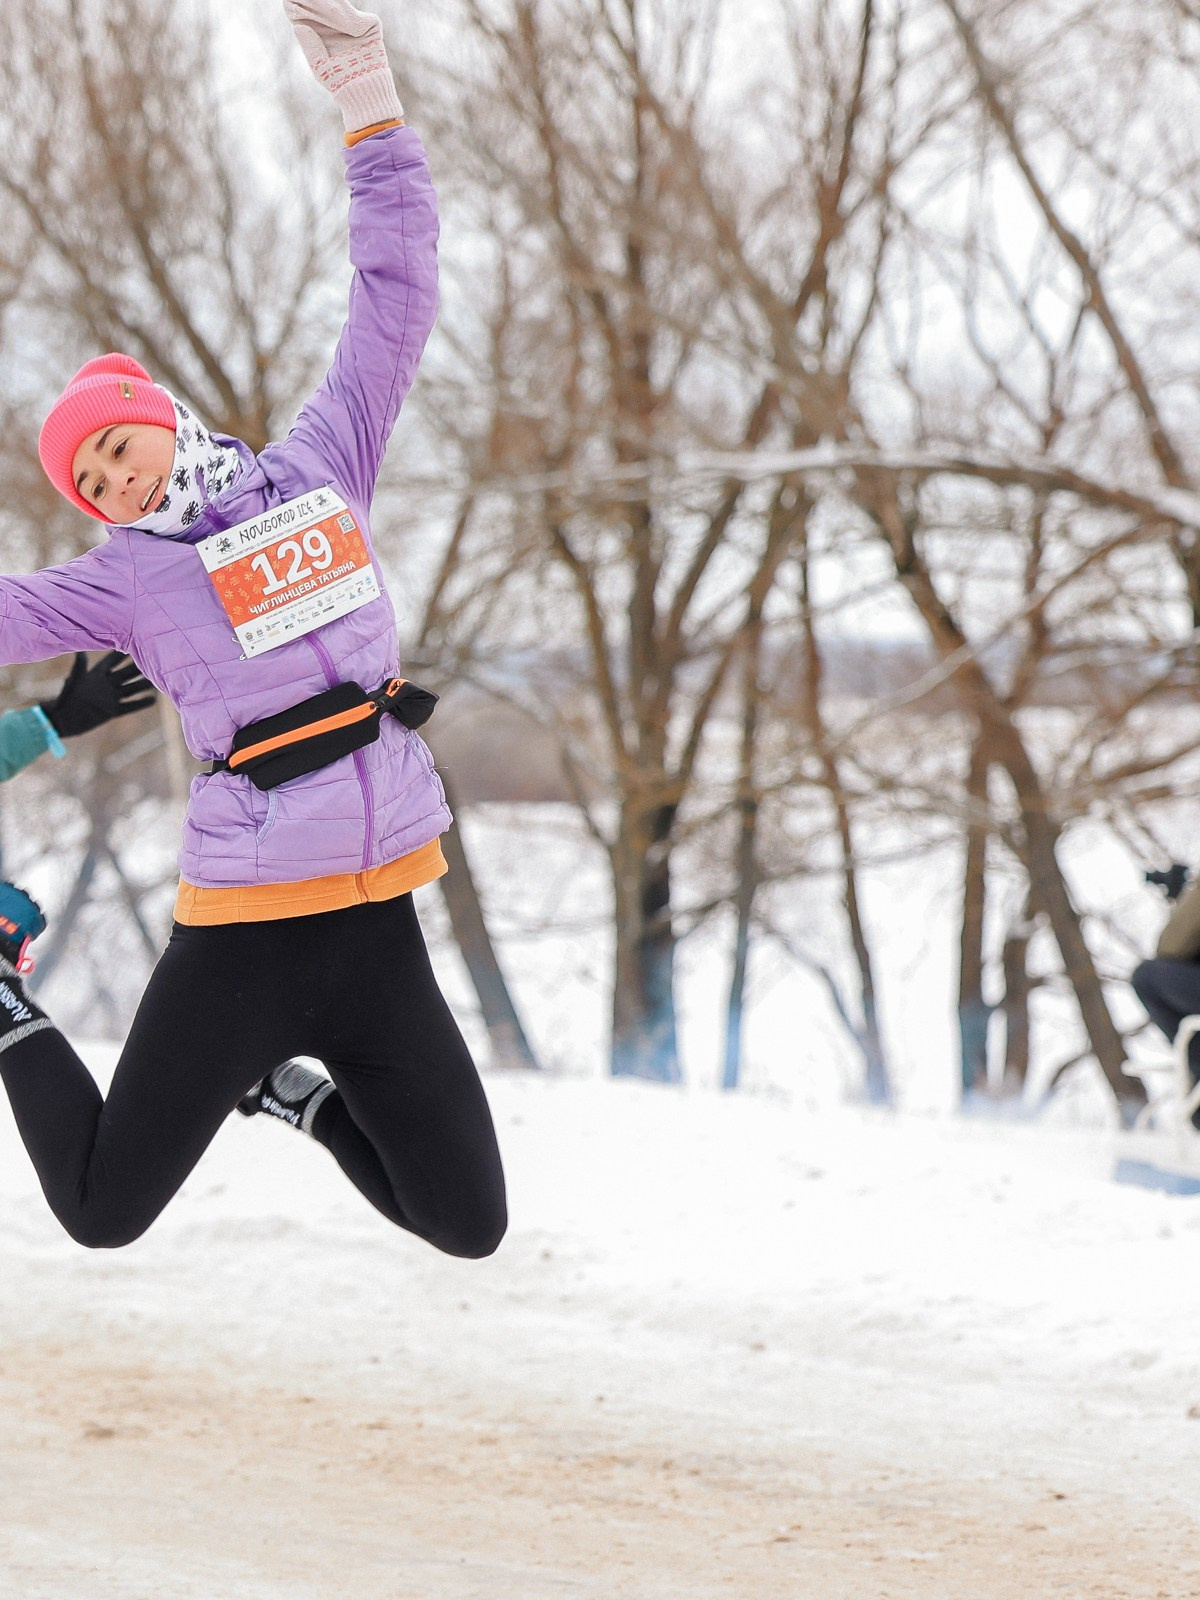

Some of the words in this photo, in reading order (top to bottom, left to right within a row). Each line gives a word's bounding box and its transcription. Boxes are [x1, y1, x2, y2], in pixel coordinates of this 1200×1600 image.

[239, 508, 295, 544] NOVGOROD
[297, 501, 314, 518] ICE
[249, 580, 317, 616] ЧИГЛИНЦЕВА
[317, 560, 356, 588] ТАТЬЯНА
[251, 528, 333, 596] 129
